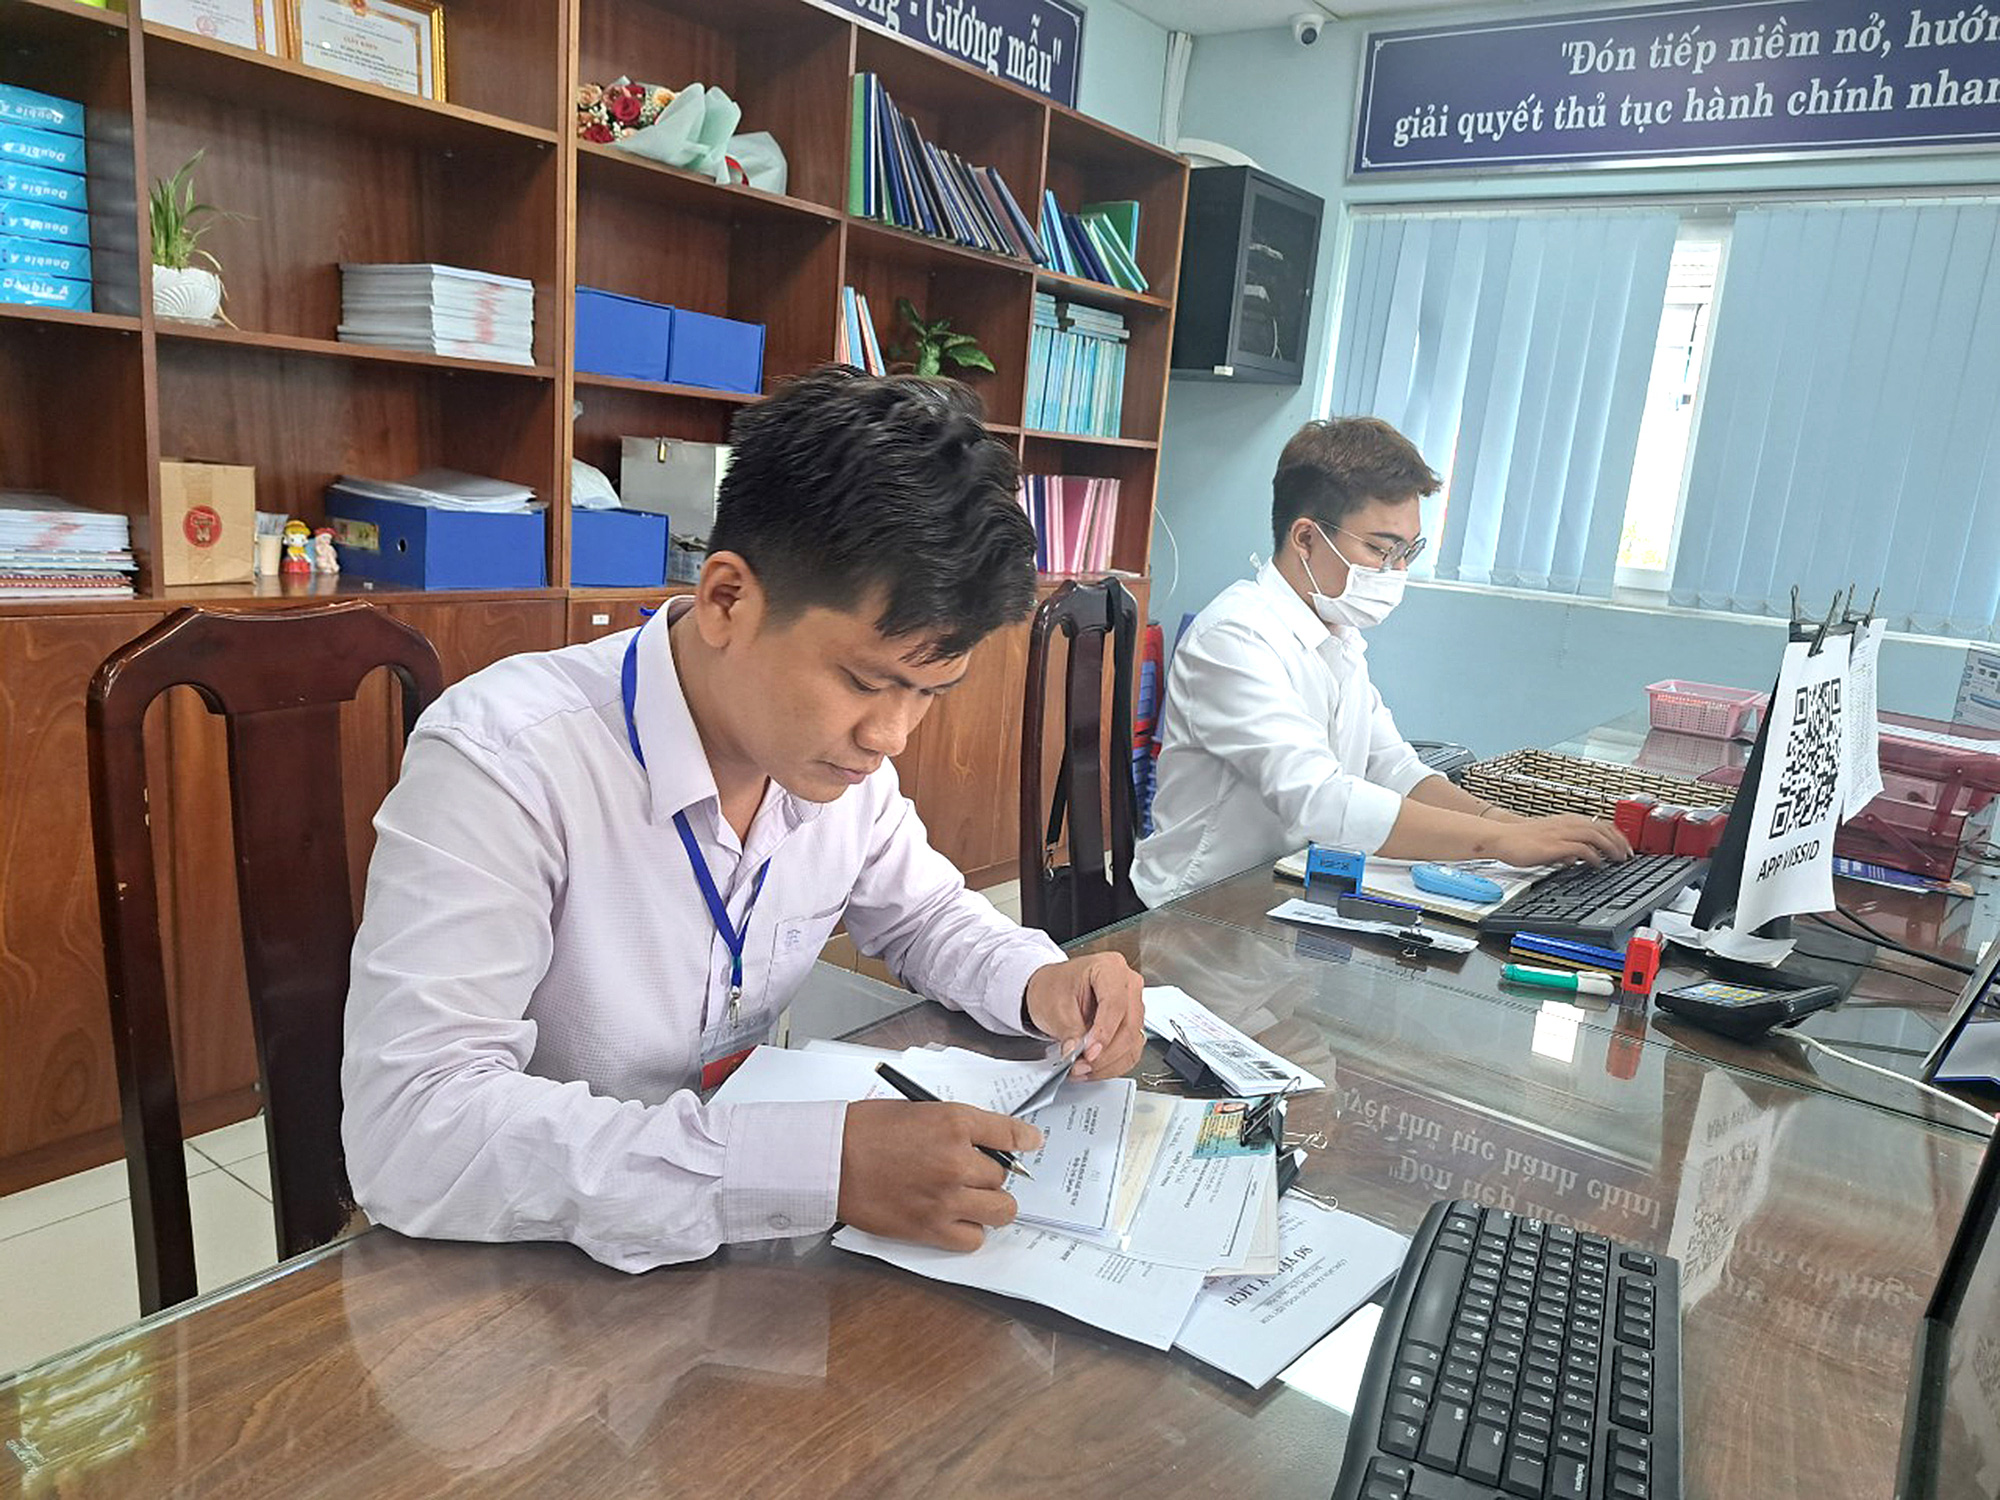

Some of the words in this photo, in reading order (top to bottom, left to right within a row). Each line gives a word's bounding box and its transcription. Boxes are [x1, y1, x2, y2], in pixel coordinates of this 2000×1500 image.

[925, 0, 1003, 77] Gương
[1006, 14, 1062, 93] mẫu"
[1562, 38, 1636, 75] "Đón
[1649, 25, 1717, 74] tiếp
[1728, 17, 1820, 62] niềm
[1832, 12, 1892, 59] nở,
[1393, 103, 1449, 147] giải
[1457, 93, 1544, 143] quyết
[1554, 91, 1607, 130] thủ
[1619, 94, 1673, 133] tục
[1683, 82, 1774, 123] hành
[1787, 75, 1893, 116] chính
[19, 143, 66, 162] Double
[22, 183, 68, 200] Double
[23, 217, 69, 235] Double
[11, 253, 19, 264] A
[24, 255, 70, 269] Double
[1757, 853, 1783, 882] APP
